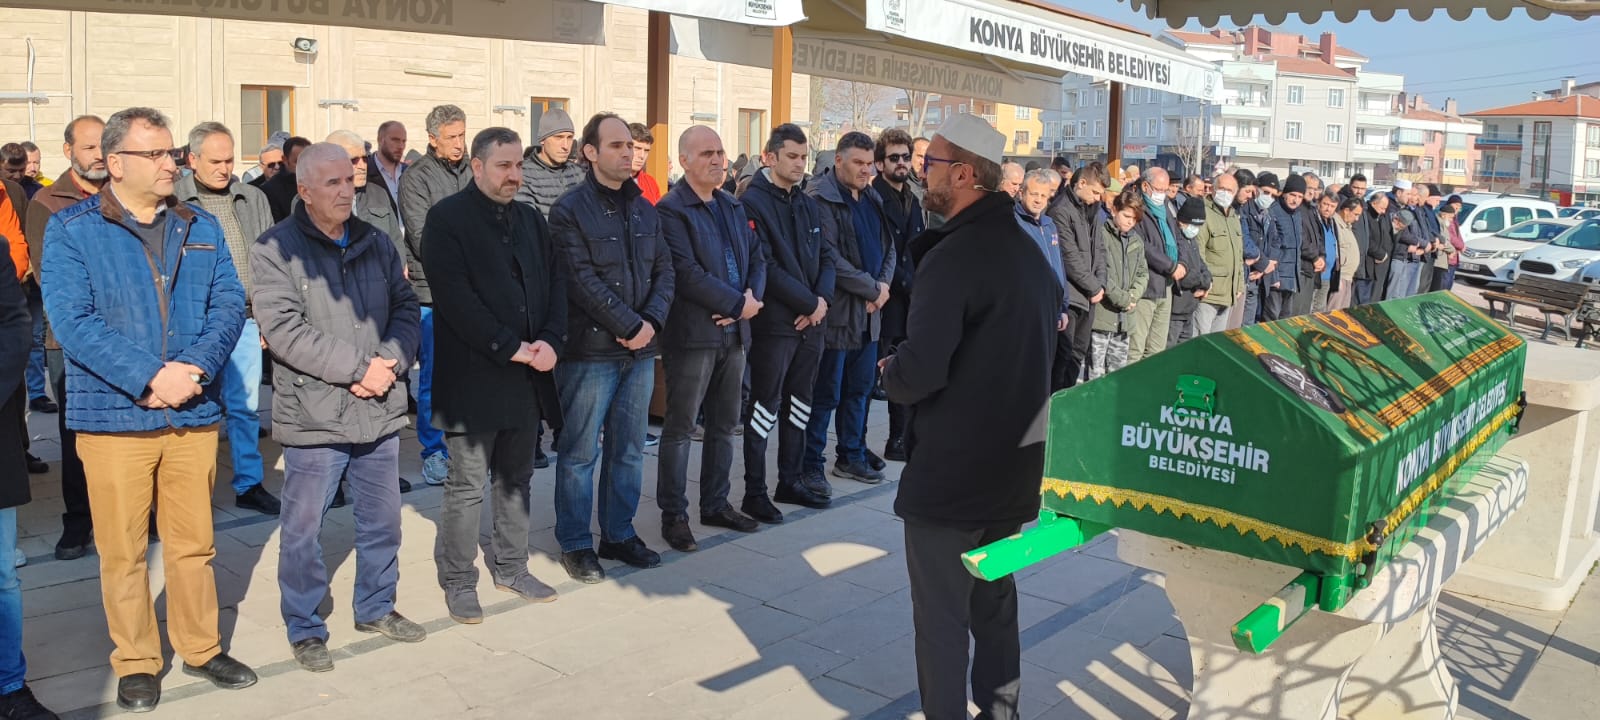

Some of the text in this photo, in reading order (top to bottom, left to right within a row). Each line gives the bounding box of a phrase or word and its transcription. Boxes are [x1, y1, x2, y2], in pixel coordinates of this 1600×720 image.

[969, 16, 1171, 86] KONYA BÜYÜKŞEHİR BELEDİYESİ
[1160, 405, 1233, 436] KONYA
[1121, 422, 1270, 473] BÜYÜKŞEHİR
[1149, 455, 1236, 484] BELEDİYESİ
[1395, 438, 1430, 496] KONYA
[1431, 398, 1477, 465] BÜYÜKŞEHİR
